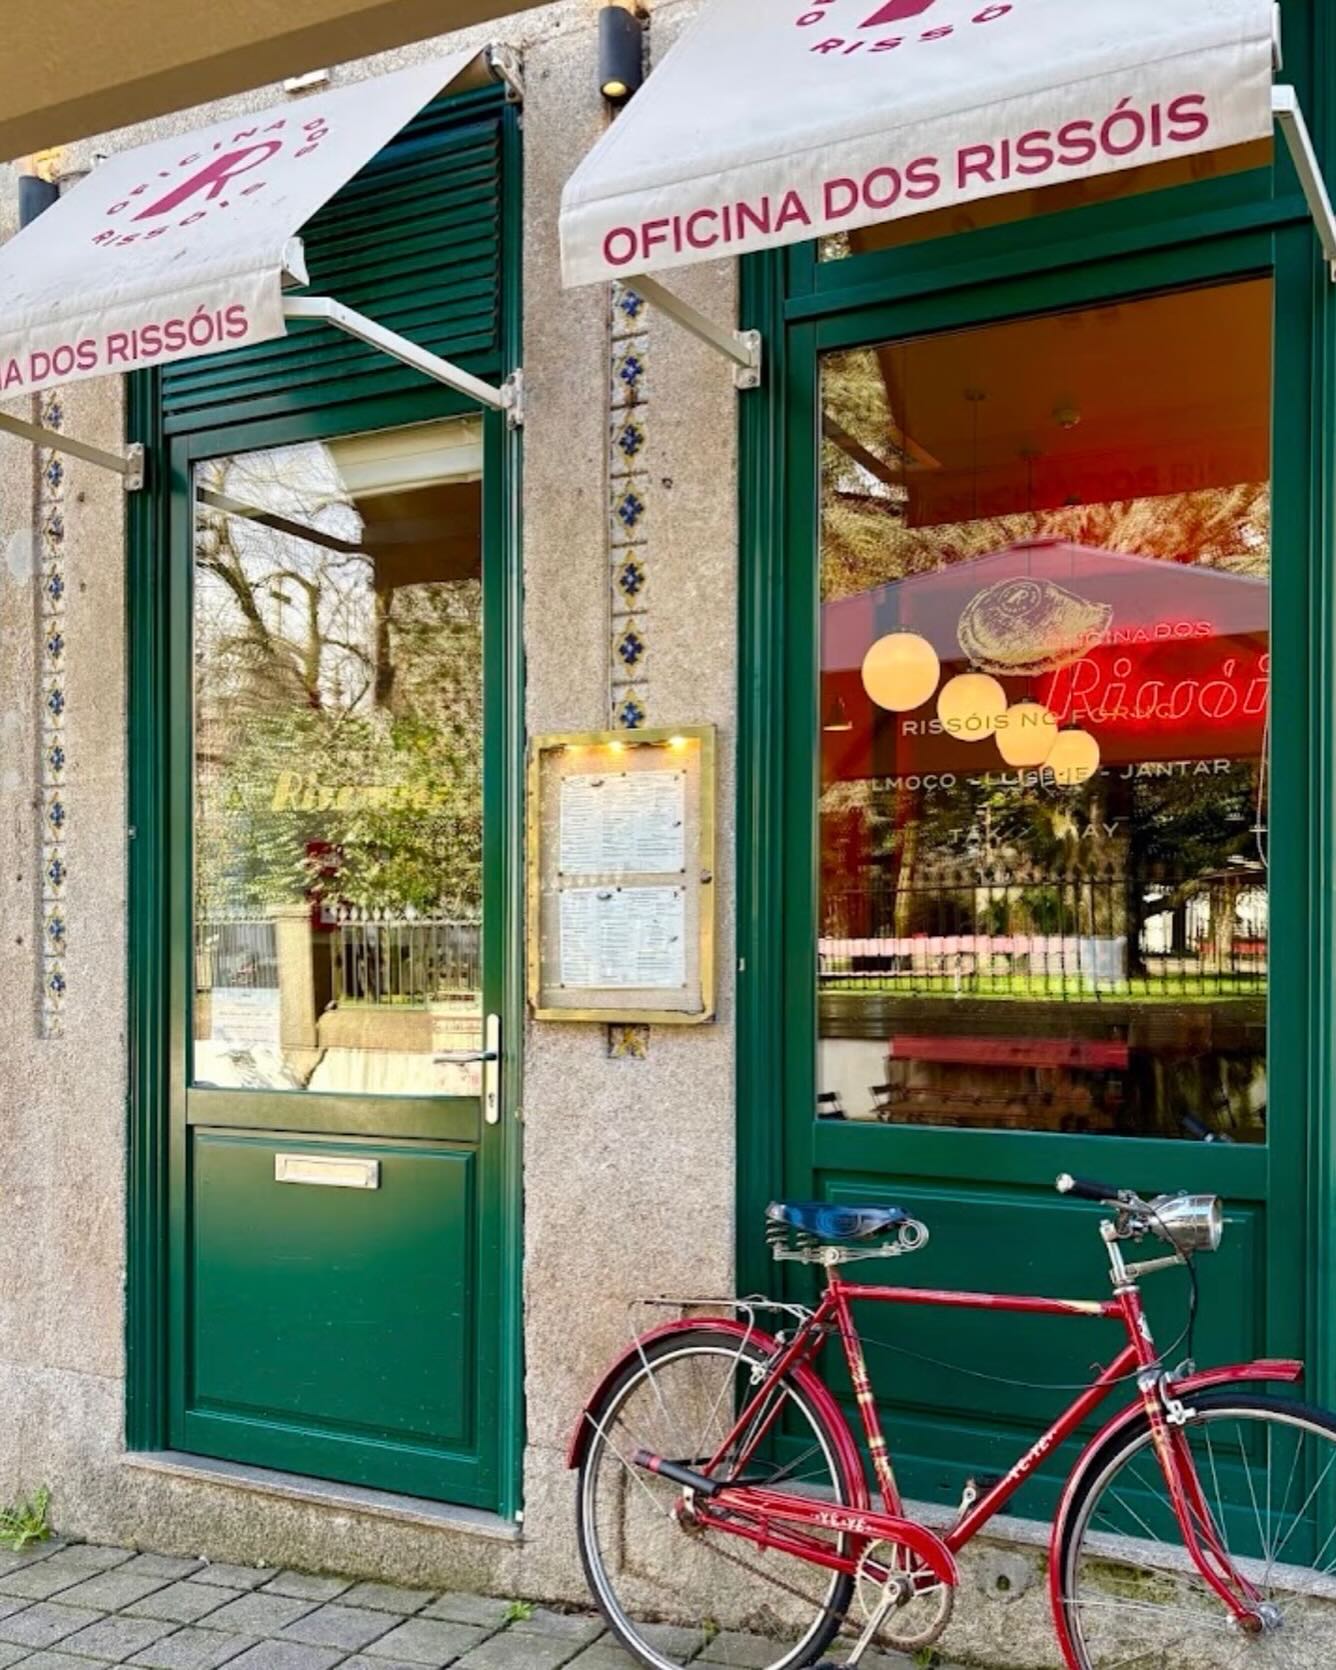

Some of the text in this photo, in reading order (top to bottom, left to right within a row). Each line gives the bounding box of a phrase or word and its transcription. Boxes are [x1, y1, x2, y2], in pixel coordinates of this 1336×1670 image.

[603, 94, 1209, 267] OFICINA DOS RISSÓIS
[30, 339, 98, 382] DOS
[107, 304, 249, 365] RISSÓIS
[1154, 620, 1212, 640] DOS
[1045, 653, 1269, 722] Rissói
[902, 712, 1010, 737] RISSÓIS
[1021, 709, 1058, 728] NO
[869, 773, 956, 793] LMOÇO
[1119, 758, 1232, 781] JANTAR
